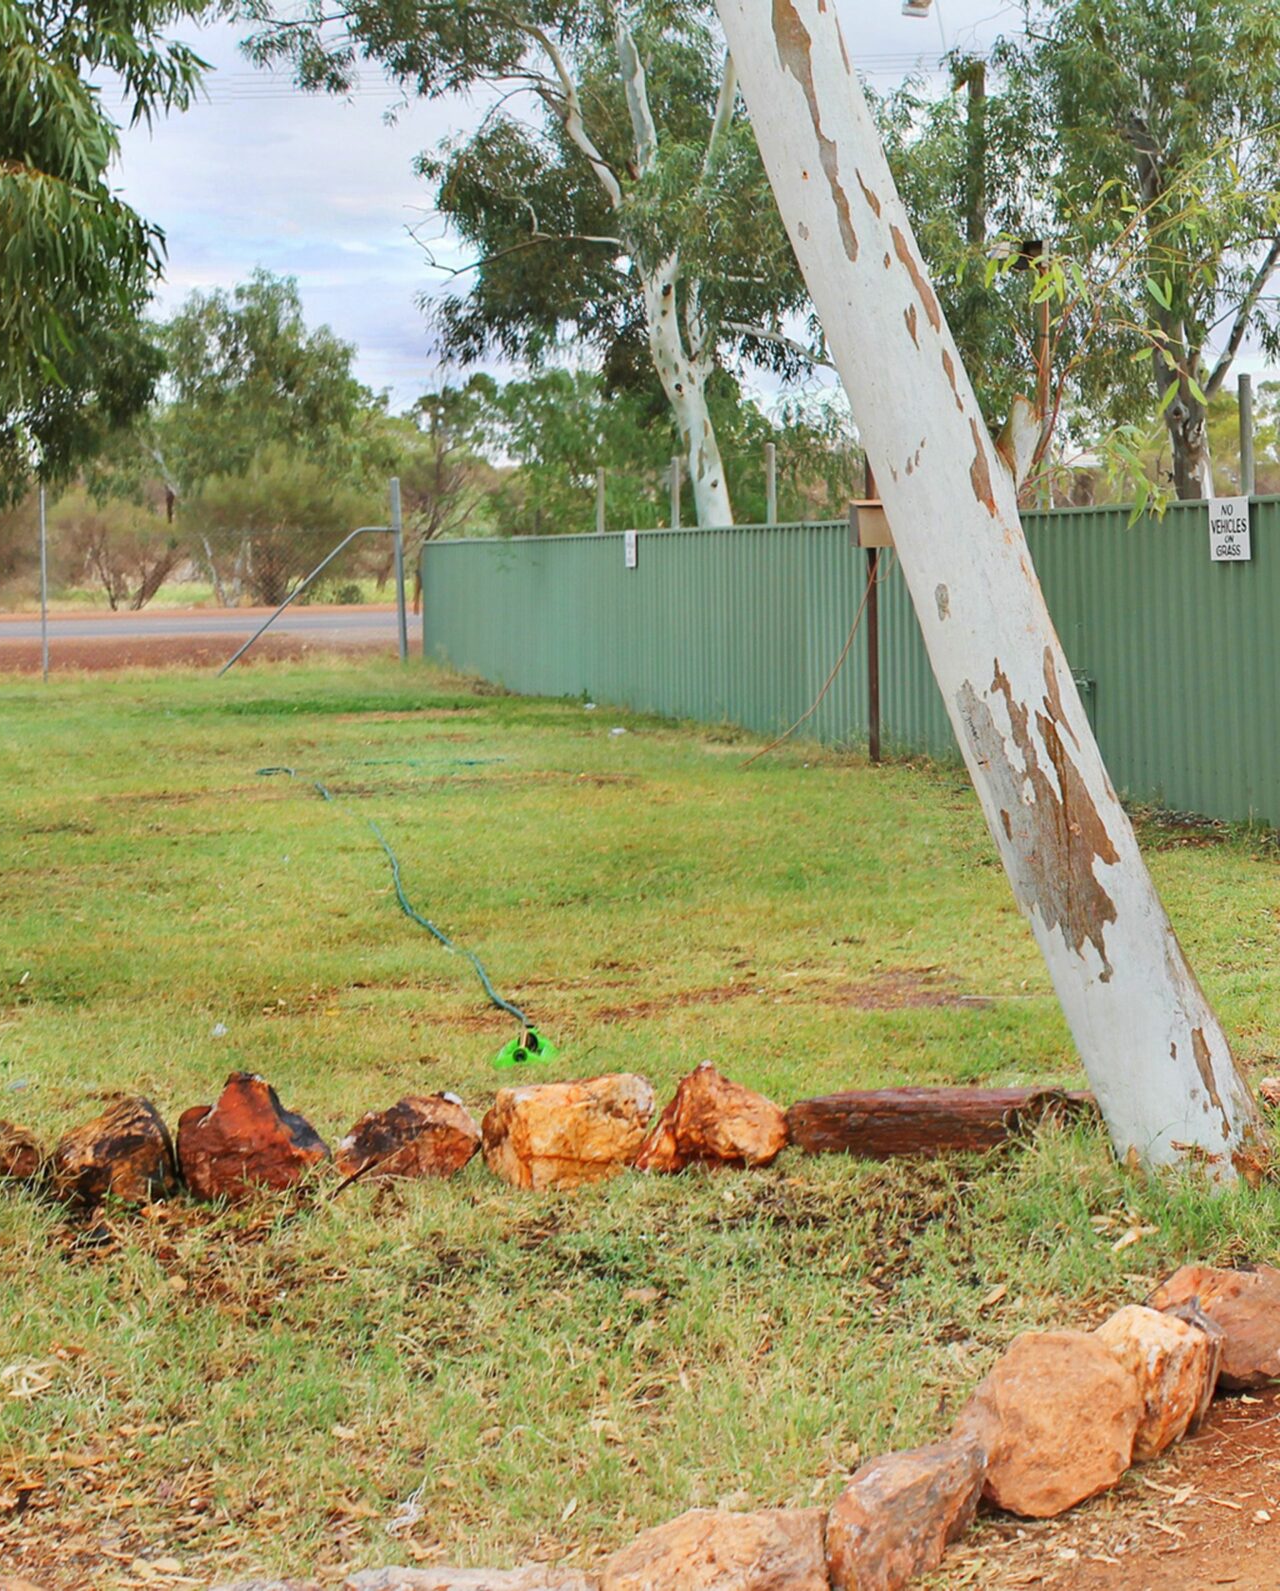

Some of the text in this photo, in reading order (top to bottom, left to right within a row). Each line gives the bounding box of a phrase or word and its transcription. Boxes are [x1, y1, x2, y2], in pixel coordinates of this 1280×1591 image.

[1221, 504, 1233, 516] NO
[1211, 518, 1247, 534] VEHICLES
[1224, 535, 1234, 544] ON
[1216, 545, 1241, 557] GRASS
